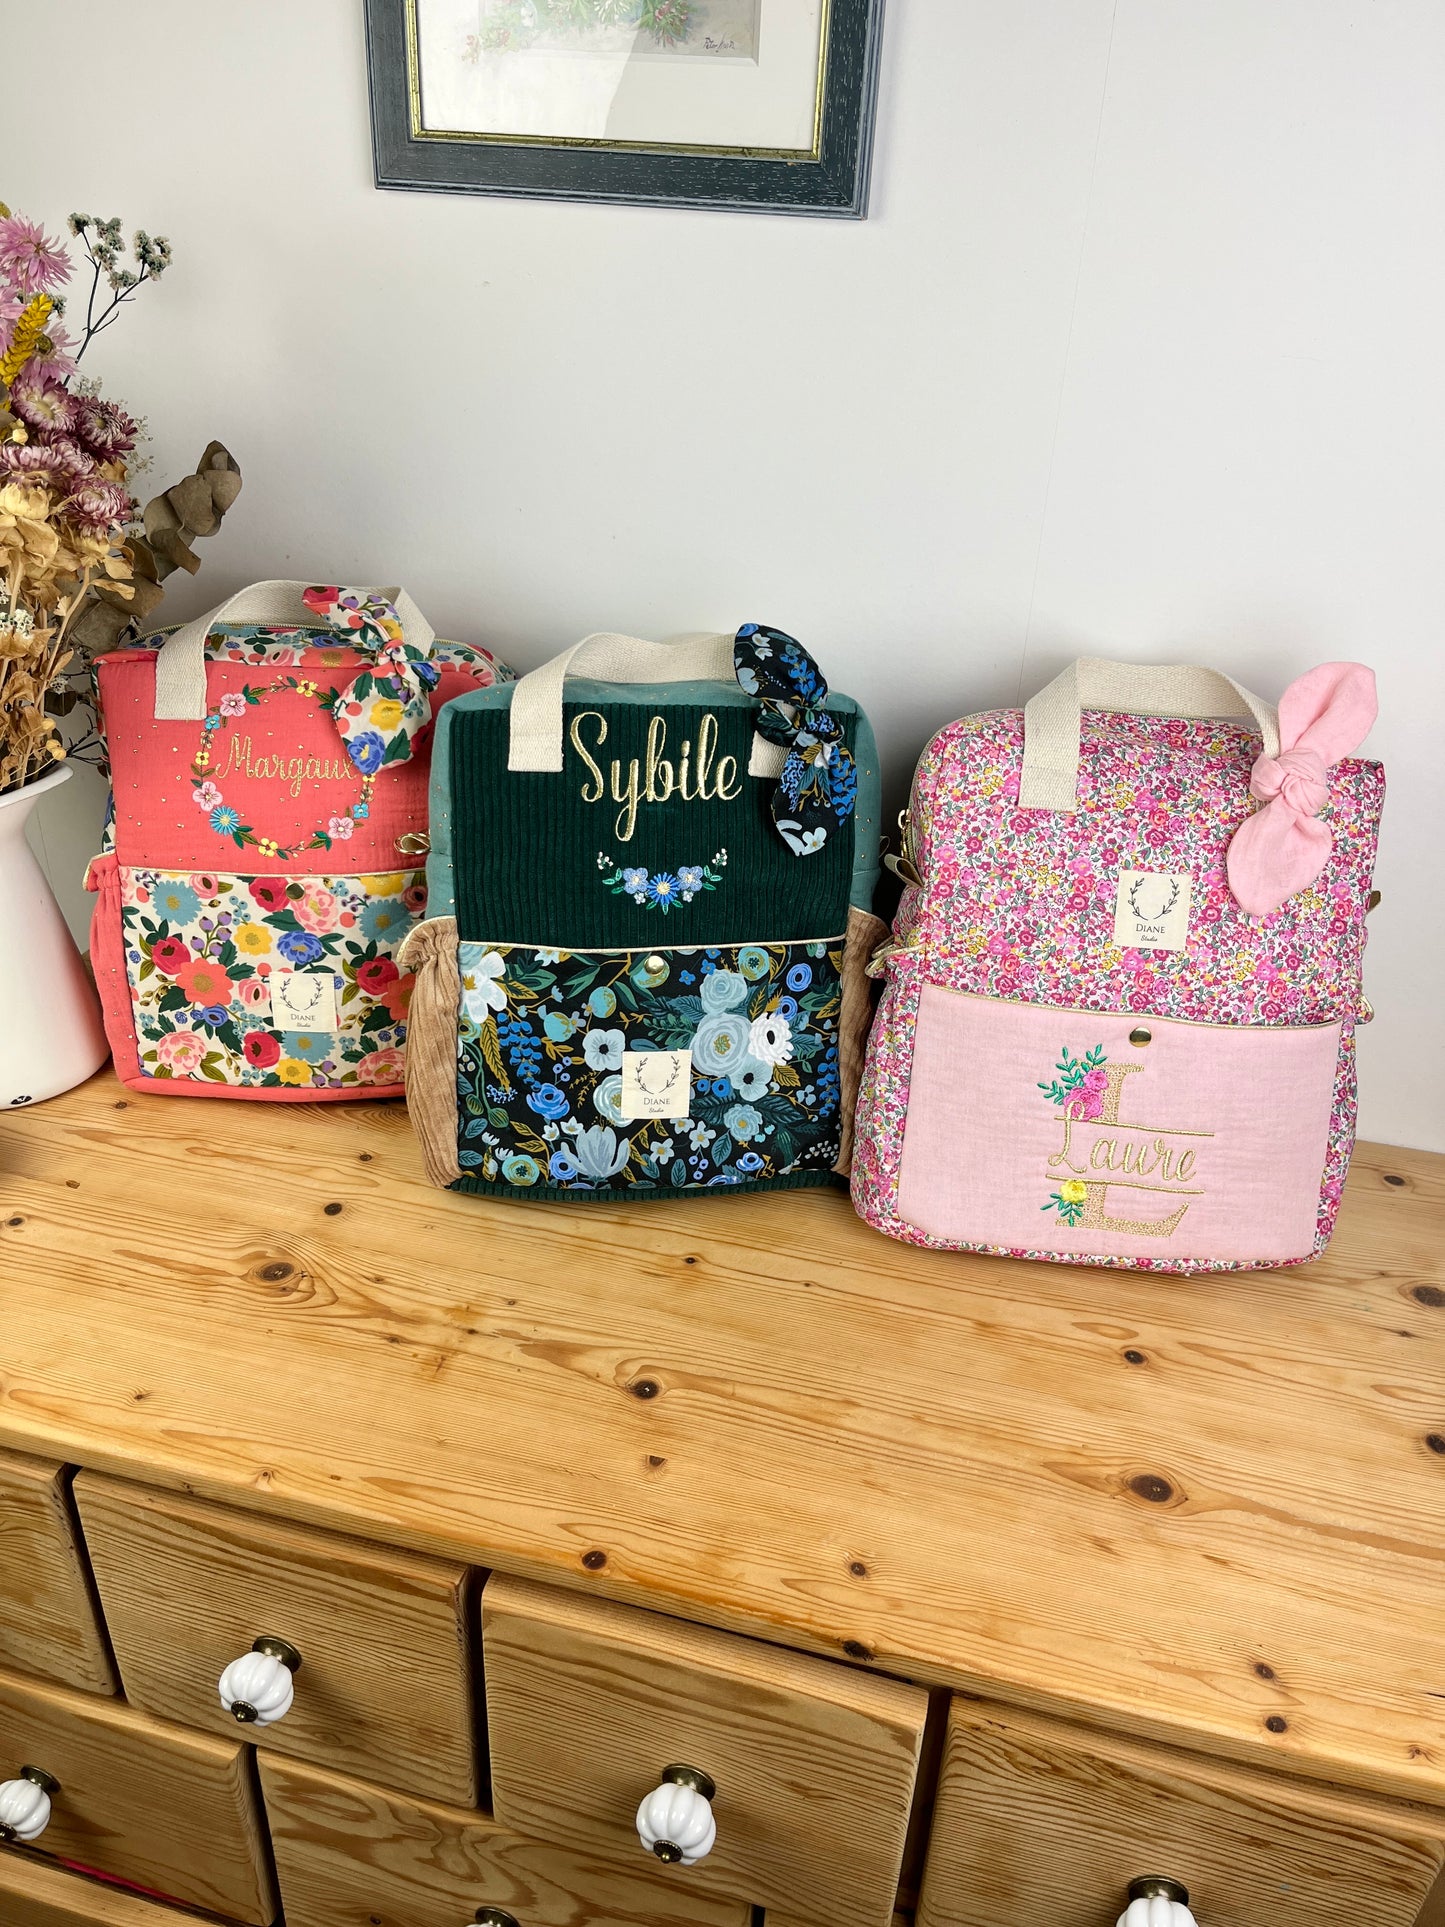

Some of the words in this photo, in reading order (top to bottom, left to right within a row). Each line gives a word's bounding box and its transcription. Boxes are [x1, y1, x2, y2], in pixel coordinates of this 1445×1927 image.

[570, 711, 742, 841] Sybile
[1136, 923, 1166, 934] DIANE
[1048, 1100, 1197, 1182] Laure
